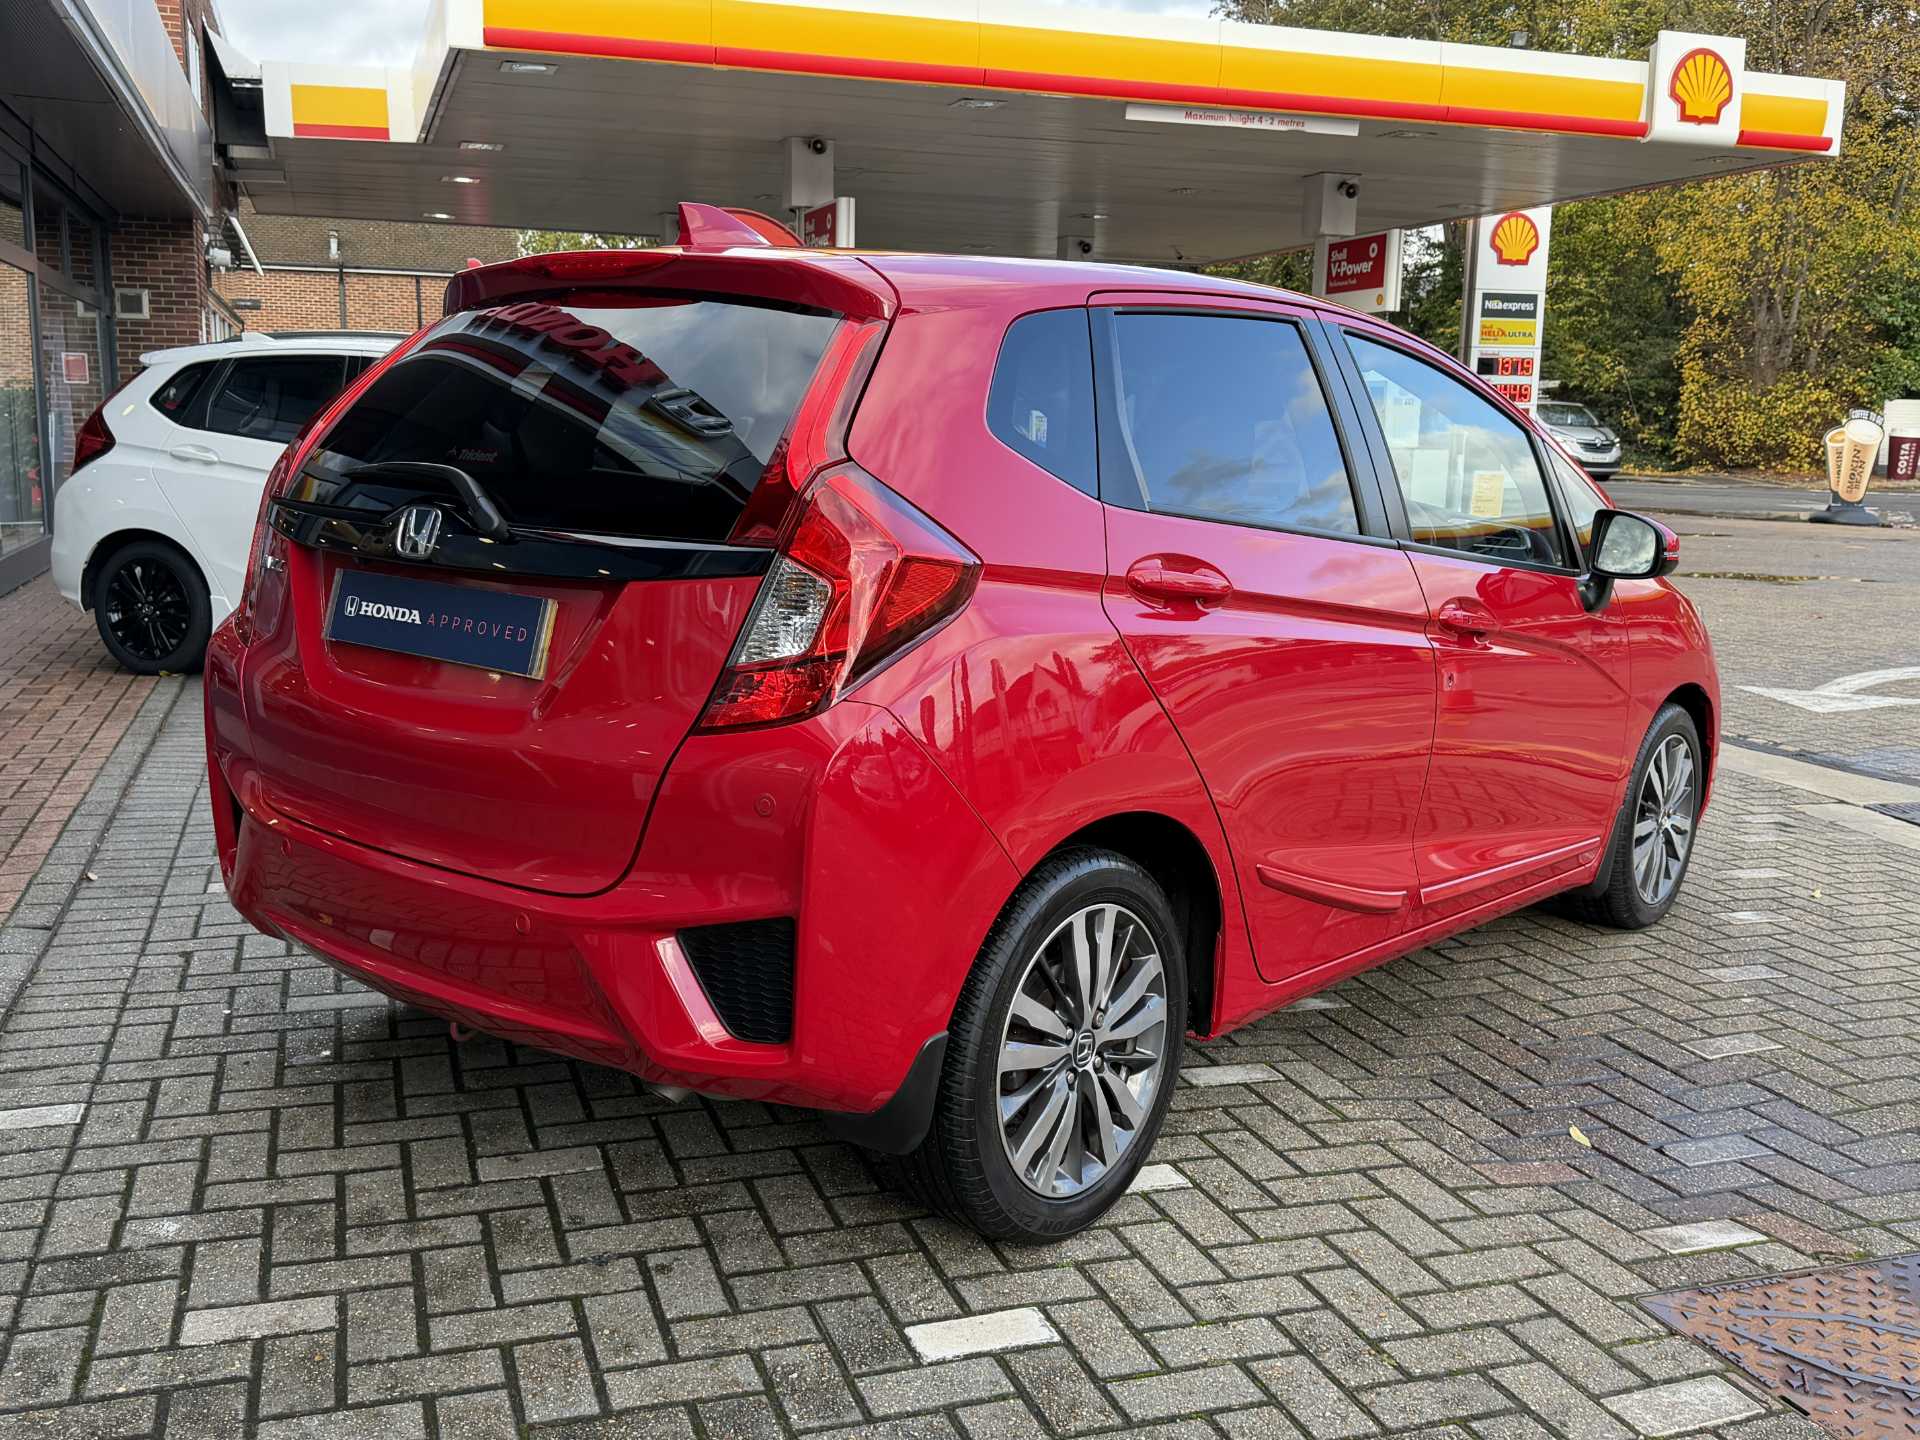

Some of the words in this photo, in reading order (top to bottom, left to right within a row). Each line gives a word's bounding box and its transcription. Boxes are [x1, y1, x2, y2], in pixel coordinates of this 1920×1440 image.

[1228, 113, 1255, 126] hight
[1277, 117, 1305, 129] metres
[1330, 261, 1373, 278] V-Power
[1896, 442, 1911, 475] COSTA
[359, 601, 422, 625] HONDA
[427, 613, 527, 642] APPROVED
